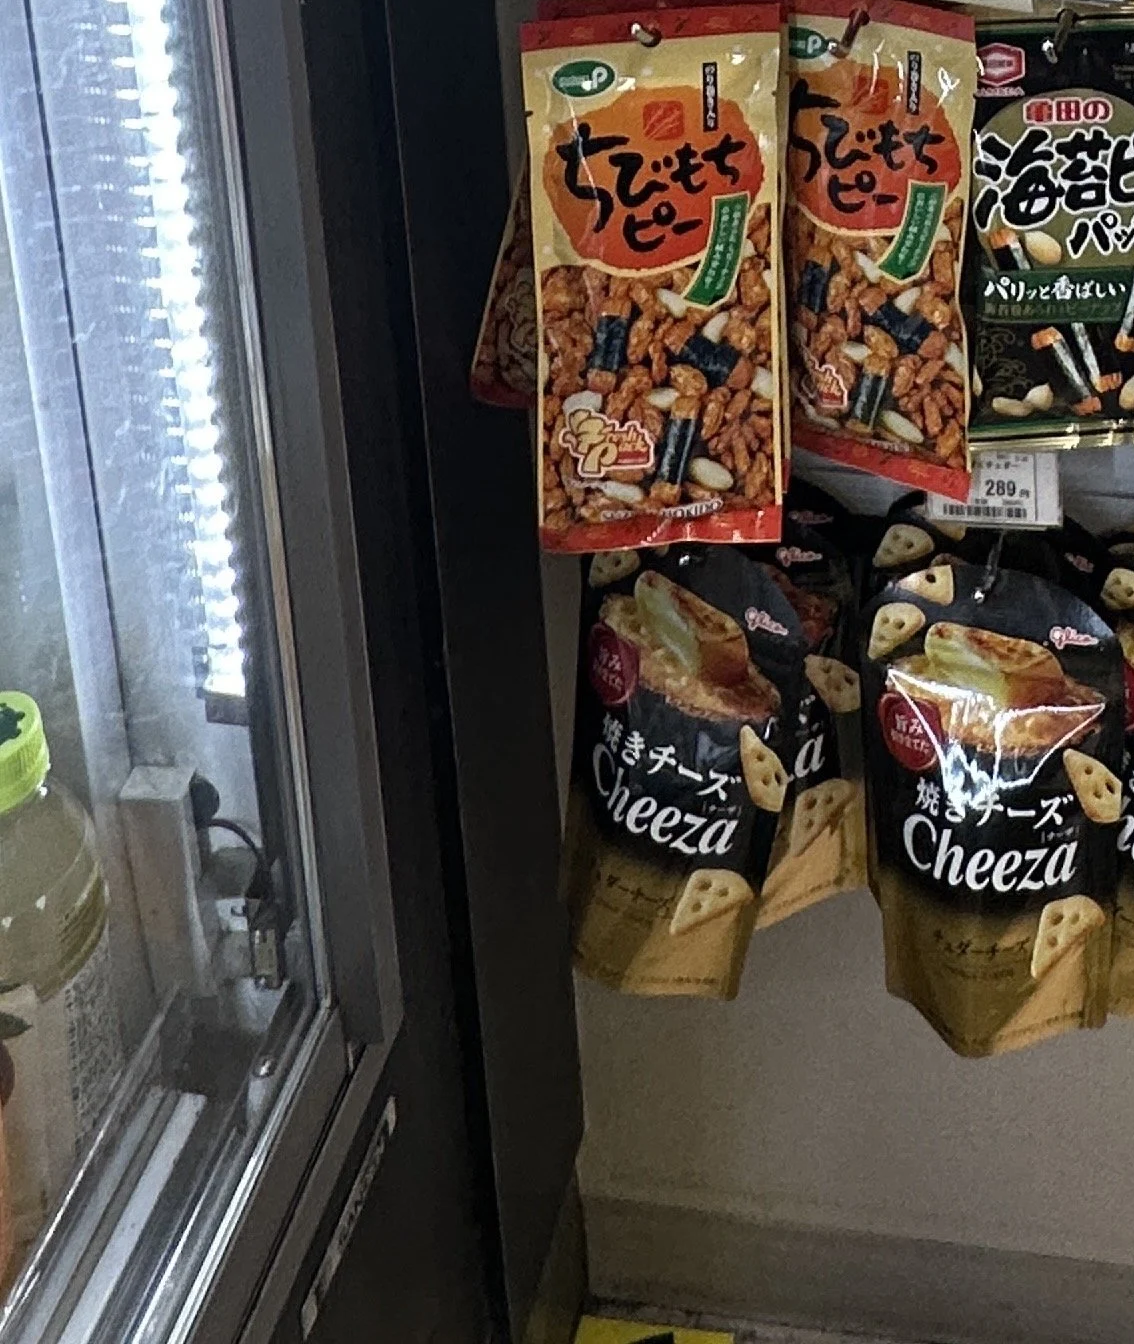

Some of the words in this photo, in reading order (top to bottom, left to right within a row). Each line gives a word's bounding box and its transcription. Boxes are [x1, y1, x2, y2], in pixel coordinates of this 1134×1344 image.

[789, 78, 947, 184] ちびもち
[1023, 98, 1113, 125] 亀田の
[556, 122, 748, 234] ちびもち
[827, 169, 900, 214] ピー
[622, 200, 704, 253] ピー
[983, 274, 1127, 302] パリッと香ばしい
[602, 713, 743, 805] 焼きチーズ
[592, 742, 740, 856] Cheeza
[915, 778, 1076, 828] 焼きチーズ
[903, 811, 1079, 894] Cheeza
